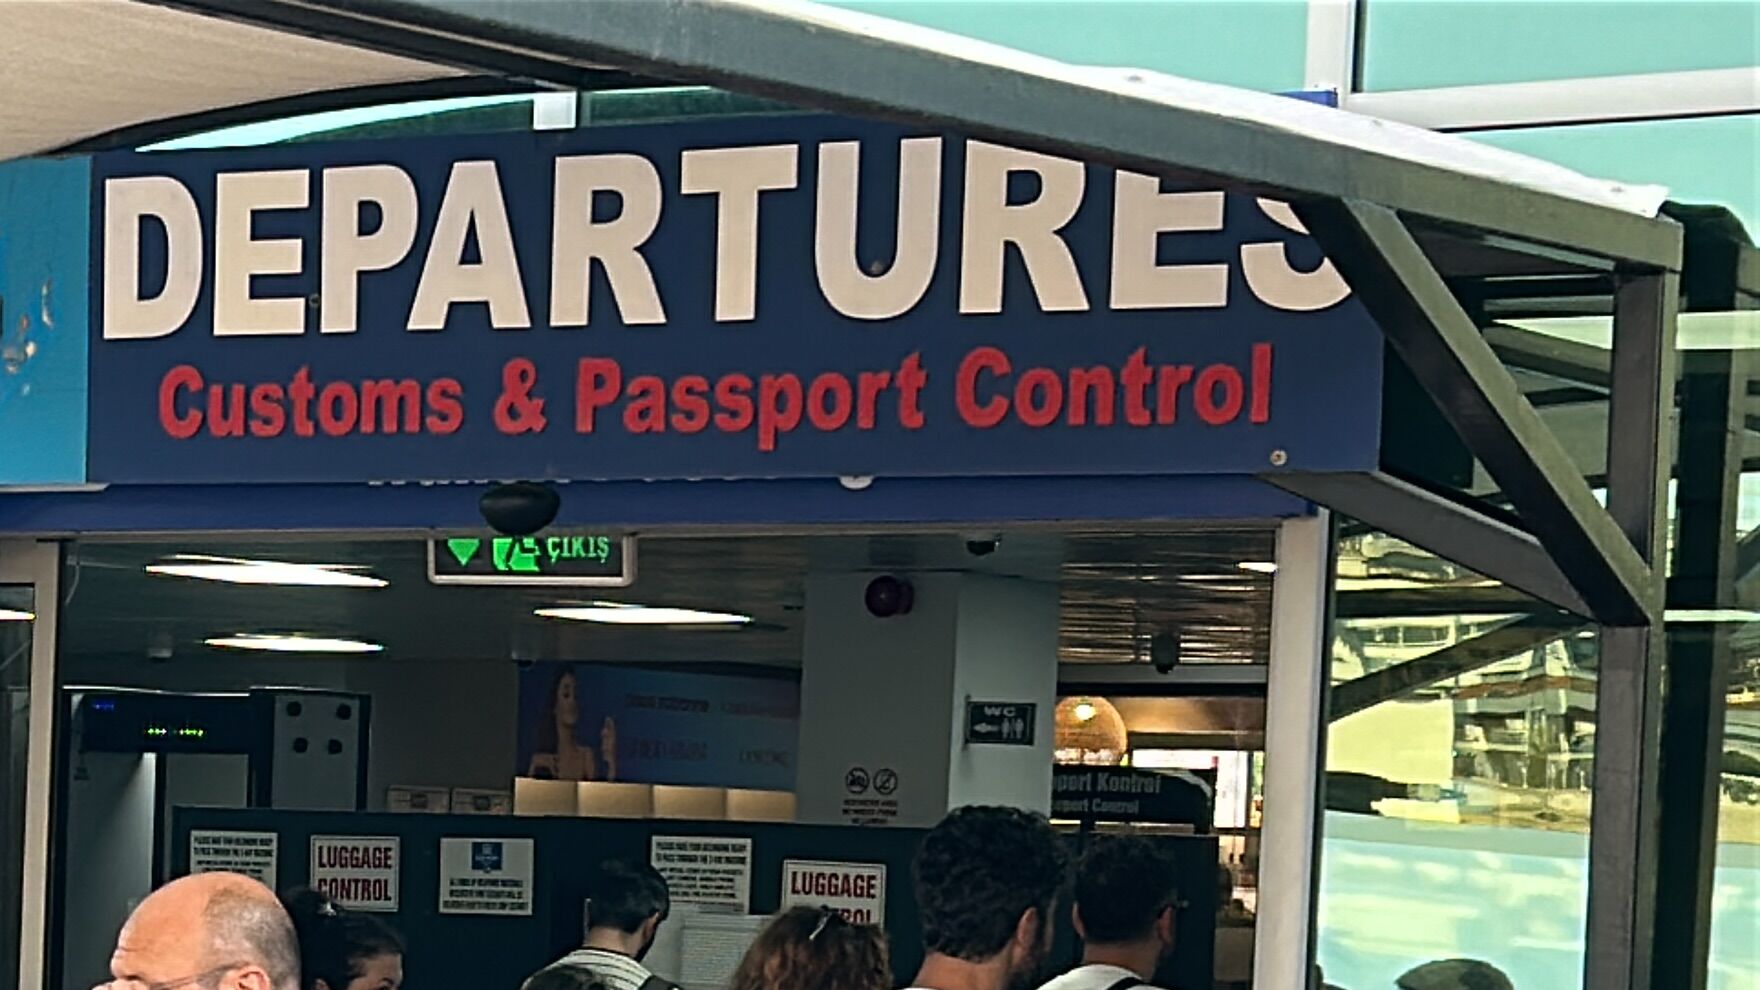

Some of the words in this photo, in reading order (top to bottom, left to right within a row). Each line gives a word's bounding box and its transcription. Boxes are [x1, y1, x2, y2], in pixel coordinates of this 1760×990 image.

[159, 364, 464, 439] Customs
[493, 357, 547, 434] &
[575, 351, 928, 452] Passport
[955, 342, 1272, 428] Control
[984, 706, 1016, 717] WC
[318, 846, 392, 869] LUGGAGE
[791, 871, 876, 899] LUGGAGE
